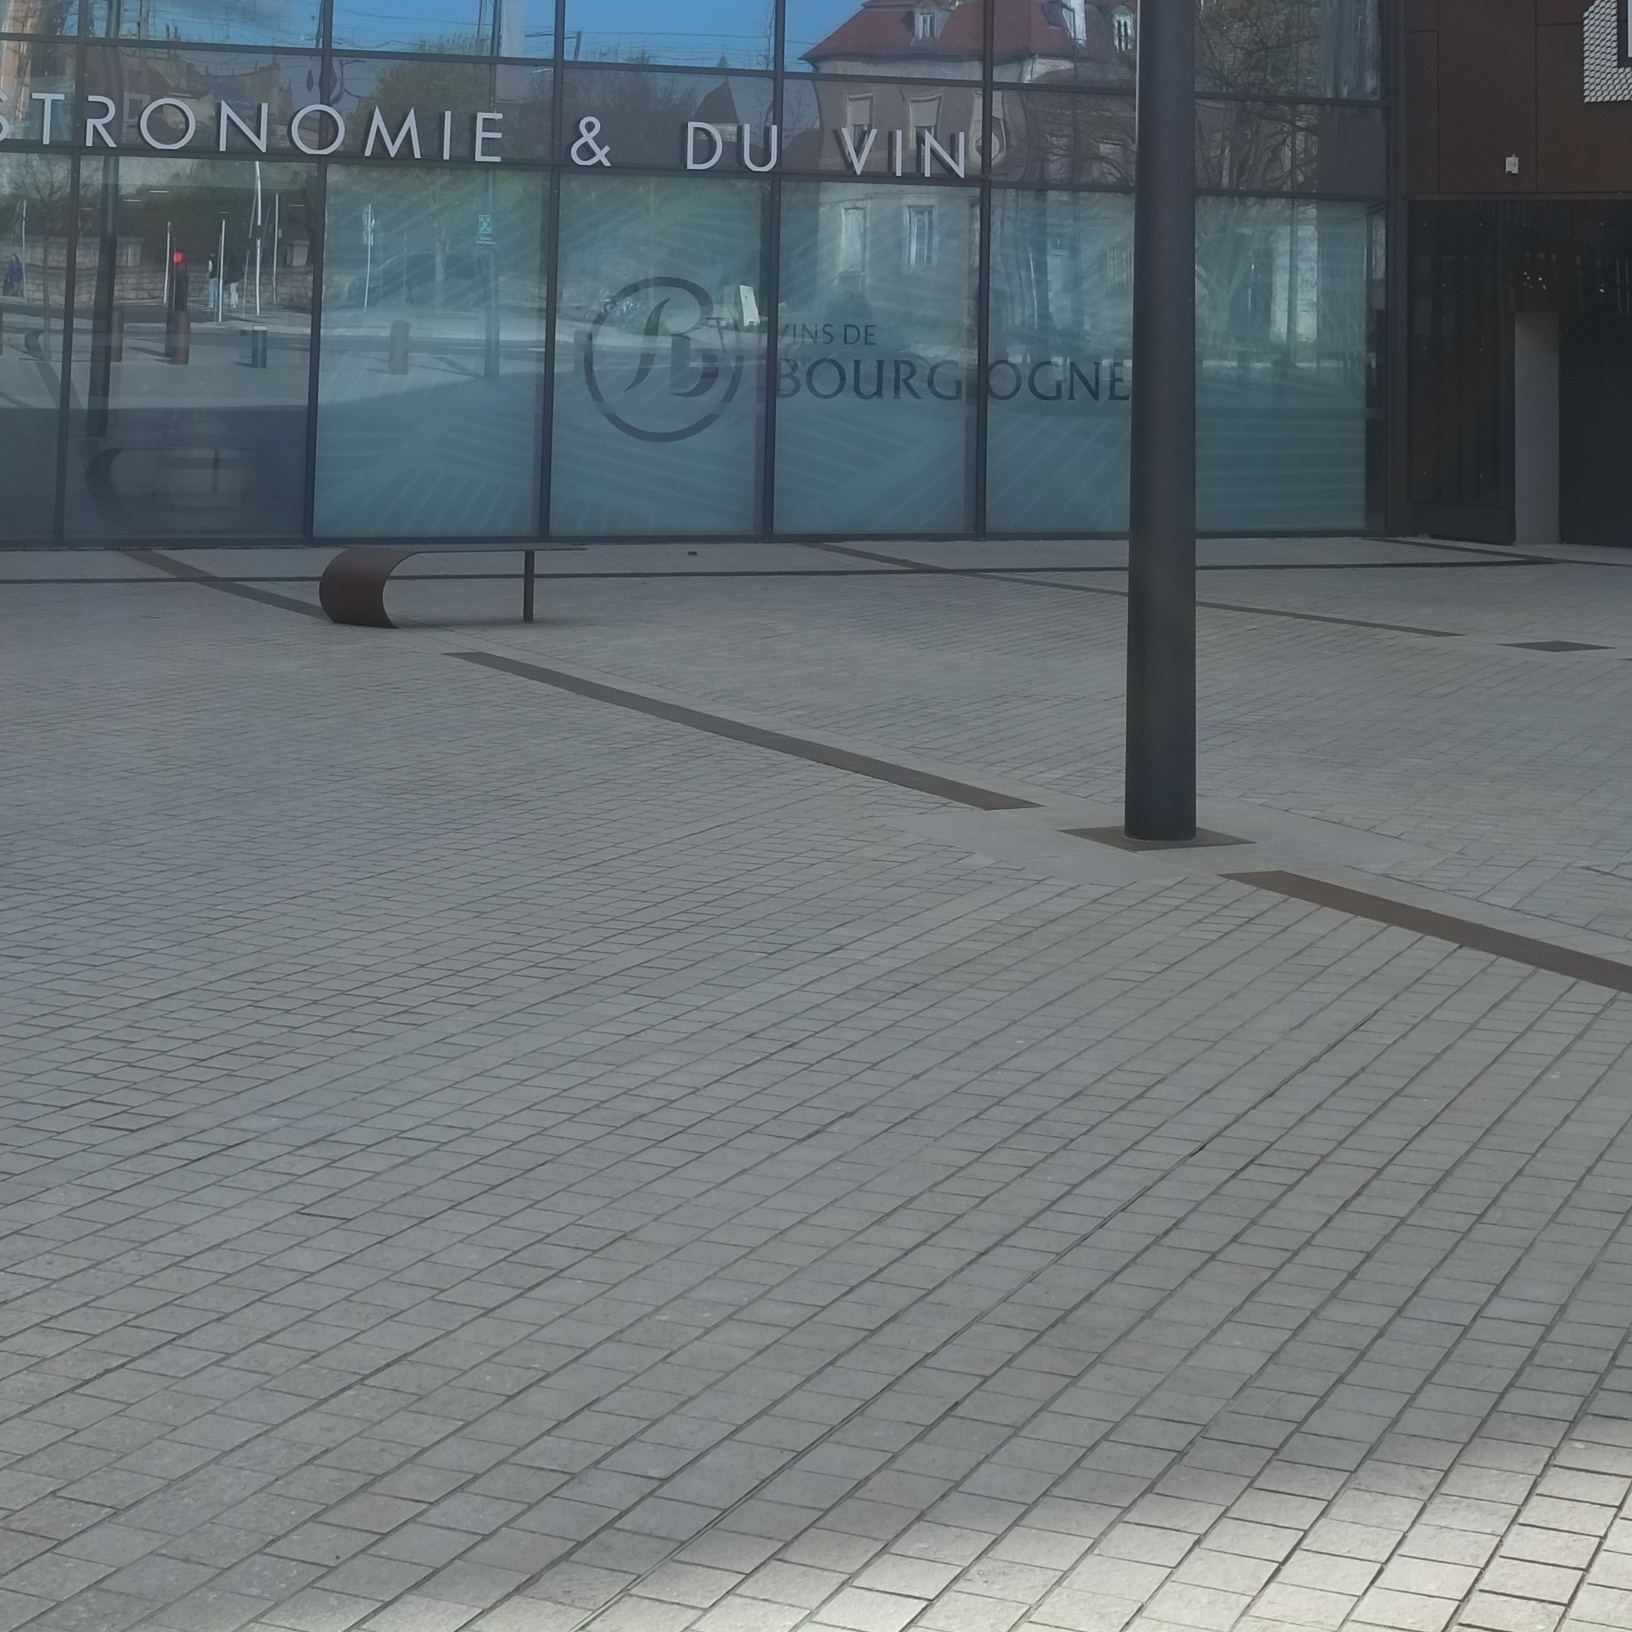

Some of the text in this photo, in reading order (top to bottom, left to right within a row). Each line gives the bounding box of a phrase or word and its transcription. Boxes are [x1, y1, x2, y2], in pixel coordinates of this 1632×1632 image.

[570, 116, 612, 167] &
[686, 121, 779, 173] DU
[841, 128, 966, 179] VIN
[843, 323, 878, 346] DE
[776, 356, 1132, 403] BOURGOGNE
